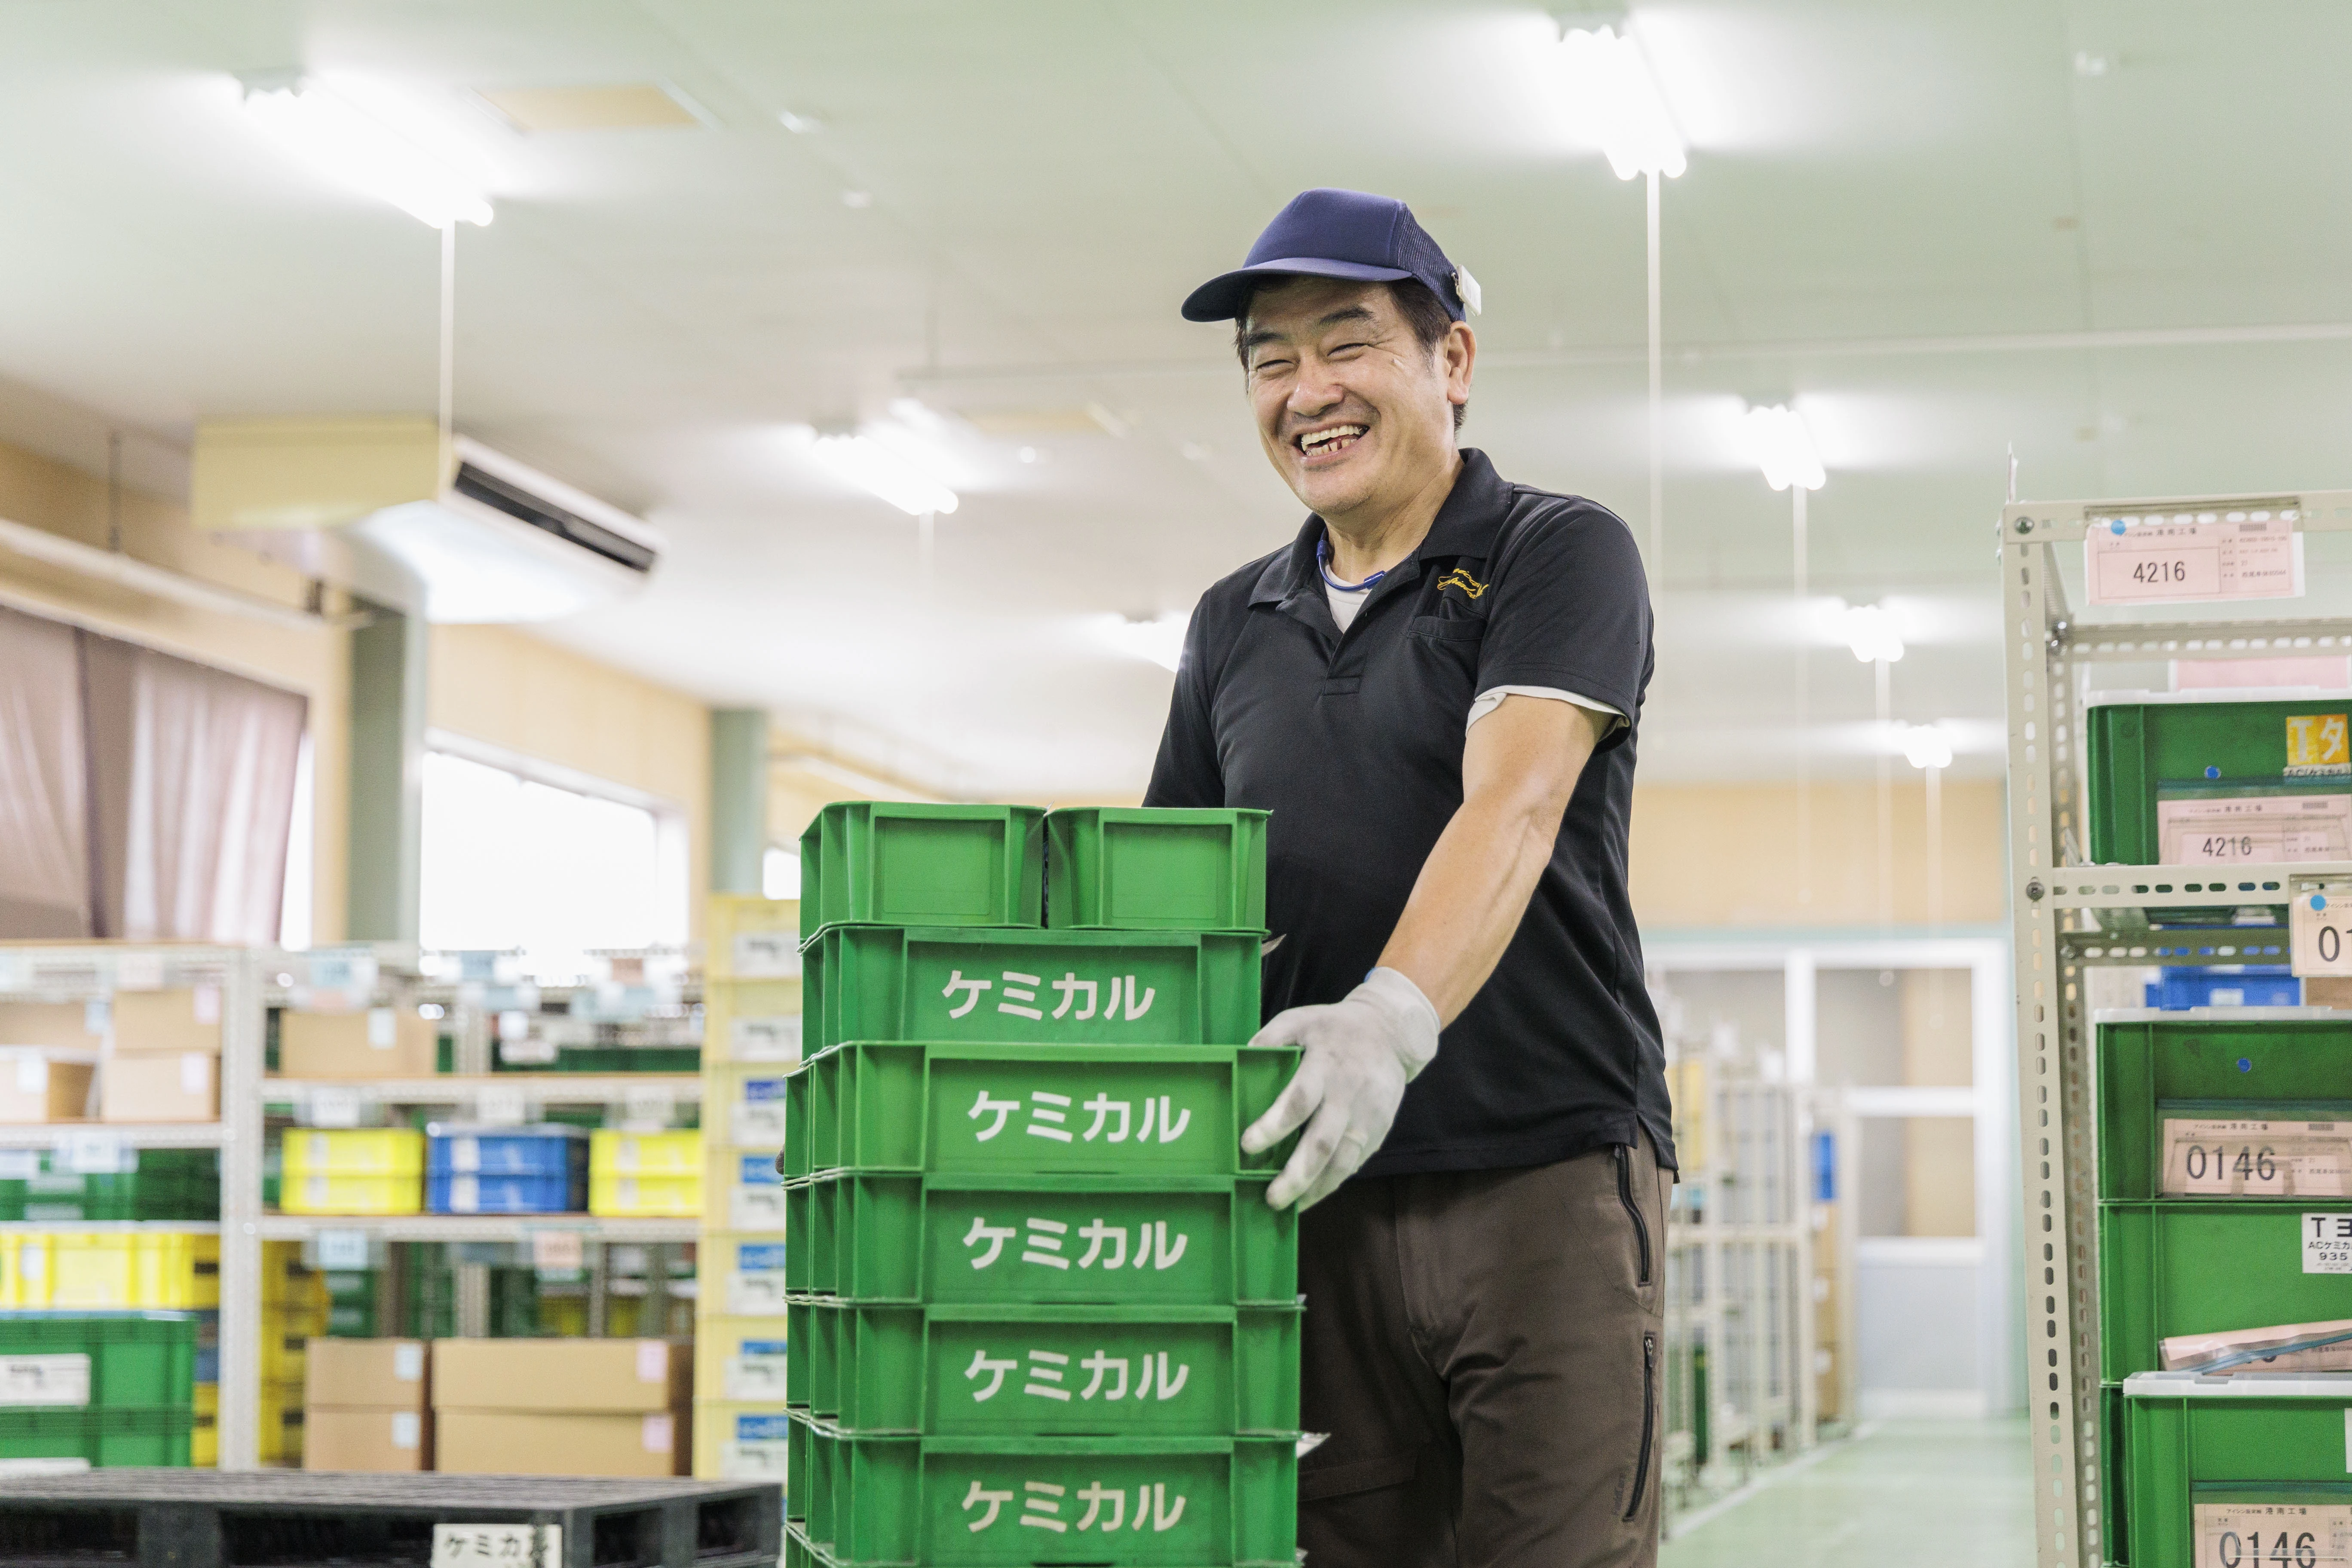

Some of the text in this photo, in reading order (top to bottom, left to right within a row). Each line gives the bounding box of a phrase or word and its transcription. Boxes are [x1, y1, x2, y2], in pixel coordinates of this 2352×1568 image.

[2133, 560, 2185, 582] 4216
[2202, 836, 2252, 857] 4216
[942, 970, 1156, 1021] ケミカル
[968, 1090, 1191, 1143] ケミカル
[2187, 1145, 2275, 1180] 0146
[963, 1217, 1188, 1270] ケミカル
[2309, 1241, 2352, 1250] ACケミカ
[2319, 1252, 2348, 1261] 935
[965, 1350, 1189, 1402] ケミカル
[962, 1482, 1186, 1533] ケミカル
[2220, 1531, 2316, 1568] 0146
